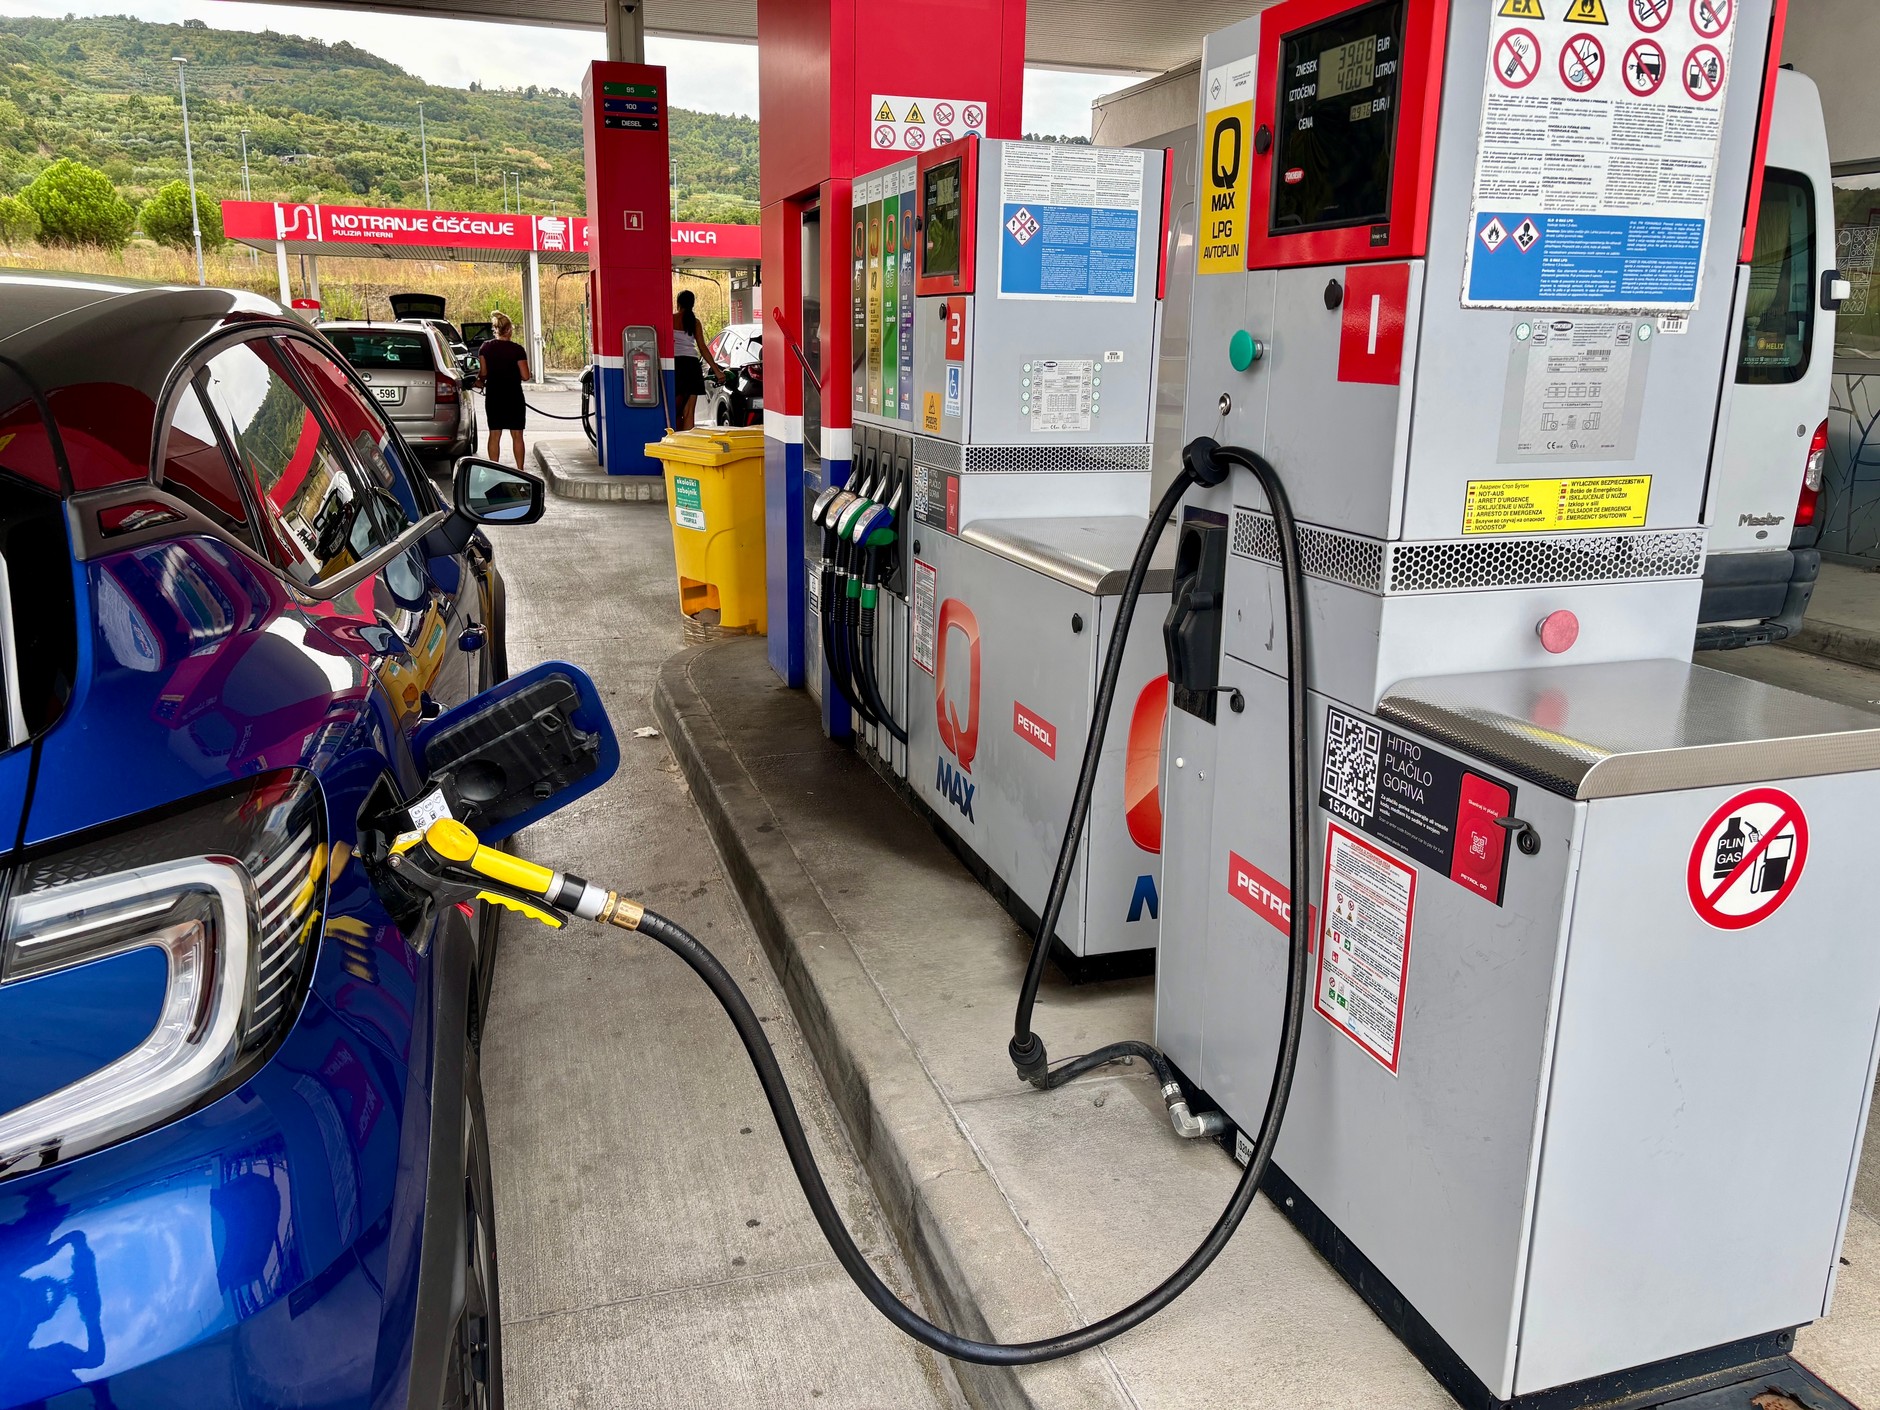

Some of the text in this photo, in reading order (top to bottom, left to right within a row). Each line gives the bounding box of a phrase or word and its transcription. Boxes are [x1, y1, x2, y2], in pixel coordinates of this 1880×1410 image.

[1338, 38, 1374, 70] 39.08
[1377, 37, 1390, 52] EUR
[1296, 60, 1317, 77] ZNESEK
[1338, 64, 1372, 91] 40.04
[1375, 60, 1397, 78] LITROV
[1289, 84, 1316, 102] IZTOČENO
[881, 111, 890, 120] EX
[1299, 116, 1313, 130] CENA
[1212, 116, 1241, 189] Q
[1212, 192, 1236, 212] MAX
[331, 214, 514, 235] NOTRANJE ČIŠČENJE
[1212, 220, 1232, 239] LPG
[1204, 244, 1239, 259] AVTOPLIN
[951, 312, 960, 345] 3
[1738, 512, 1785, 526] Master
[936, 597, 981, 775] Q
[1018, 714, 1051, 747] PETROL
[1387, 734, 1421, 760] HITRO
[1385, 753, 1432, 786] PLAČILO
[936, 756, 975, 824] MAX
[1383, 772, 1424, 804] GORIVA
[1328, 798, 1365, 827] 154401
[1390, 806, 1406, 817] medtem
[1411, 817, 1423, 826] sedite
[1426, 825, 1440, 836] svojem
[1398, 803, 1410, 812] goriva
[1410, 809, 1428, 822] skenirajte
[1434, 822, 1448, 832] vnesite
[1718, 837, 1744, 850] PLIN
[1717, 852, 1742, 864] GAS
[1460, 873, 1479, 886] PETROL
[1237, 870, 1290, 923] PETRO
